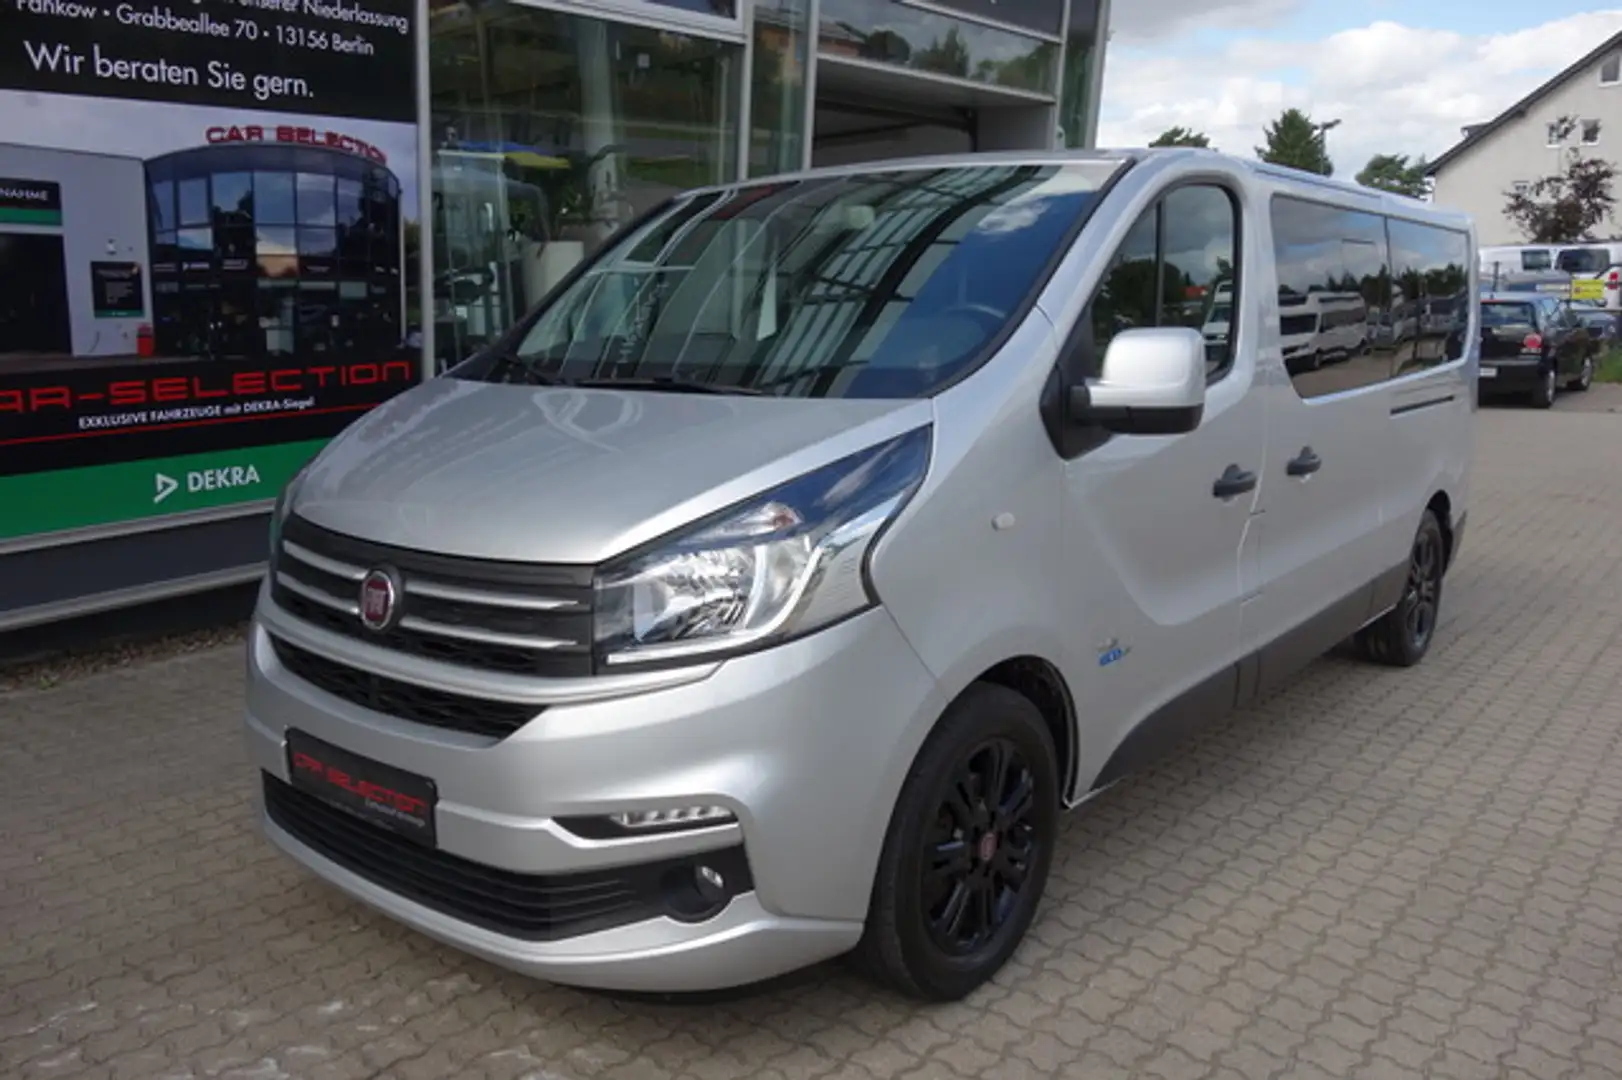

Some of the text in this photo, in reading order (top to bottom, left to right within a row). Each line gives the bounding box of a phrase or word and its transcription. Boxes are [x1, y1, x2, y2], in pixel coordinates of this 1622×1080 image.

[116, 3, 229, 37] Grabbeallee
[234, 19, 258, 40] 70
[276, 25, 328, 50] 13156
[331, 33, 374, 55] Berlin
[304, 0, 408, 34] Niederlassung
[23, 39, 314, 100] Wir beraten Sie gern.
[206, 125, 264, 144] CAR
[79, 411, 147, 430] EXKLUSIVE
[150, 404, 222, 422] FAHRZEUGE
[224, 403, 242, 415] mit
[187, 464, 261, 493] DEKRA
